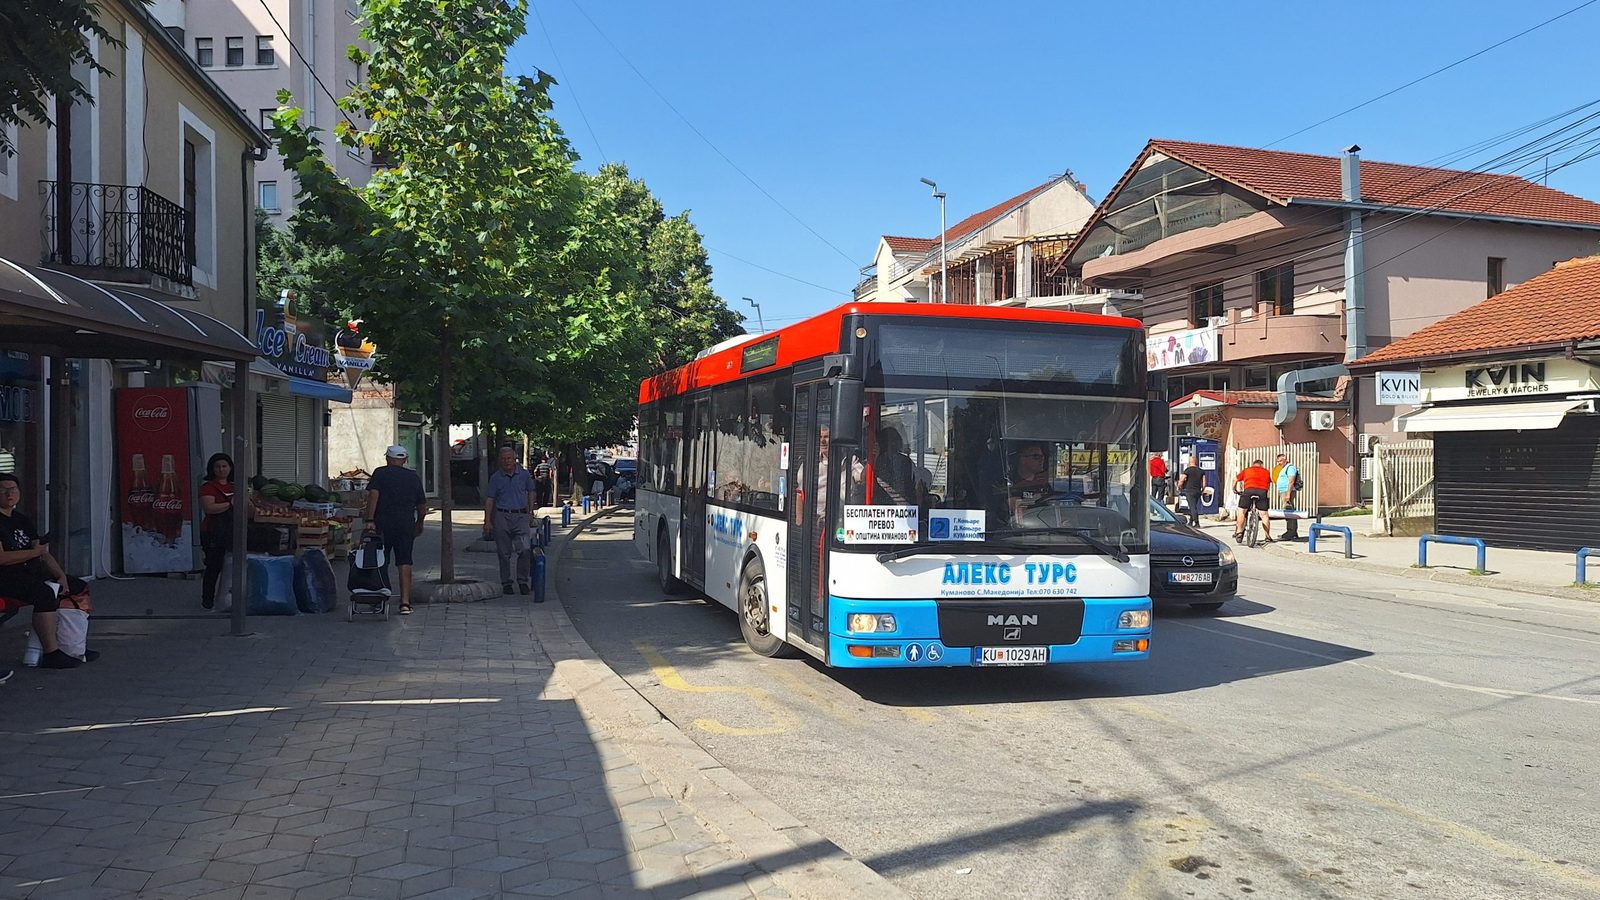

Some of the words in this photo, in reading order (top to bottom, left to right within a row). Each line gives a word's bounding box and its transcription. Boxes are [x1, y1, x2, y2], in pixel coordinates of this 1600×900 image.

[256, 308, 286, 358] Ice
[295, 332, 331, 369] Cream
[340, 359, 370, 369] VANILLA
[1465, 362, 1546, 388] KVIN
[1381, 378, 1419, 392] KVIN
[1466, 388, 1501, 398] JEWELRY
[1510, 384, 1549, 394] WATCHES
[135, 407, 168, 418] Coca-Cola
[846, 508, 885, 518] БЕСПЛАТЕН
[887, 508, 917, 518] ГРАДСКИ
[868, 520, 895, 530] ПРЕВОЗ
[935, 521, 946, 537] 2
[855, 532, 880, 541] ОПШТИНА
[881, 532, 908, 541] КУМАНОВО
[942, 562, 1011, 585] АЛЕКС
[1025, 563, 1077, 585] ТУРС
[940, 589, 975, 597] Куманово
[987, 614, 1038, 626] MAN
